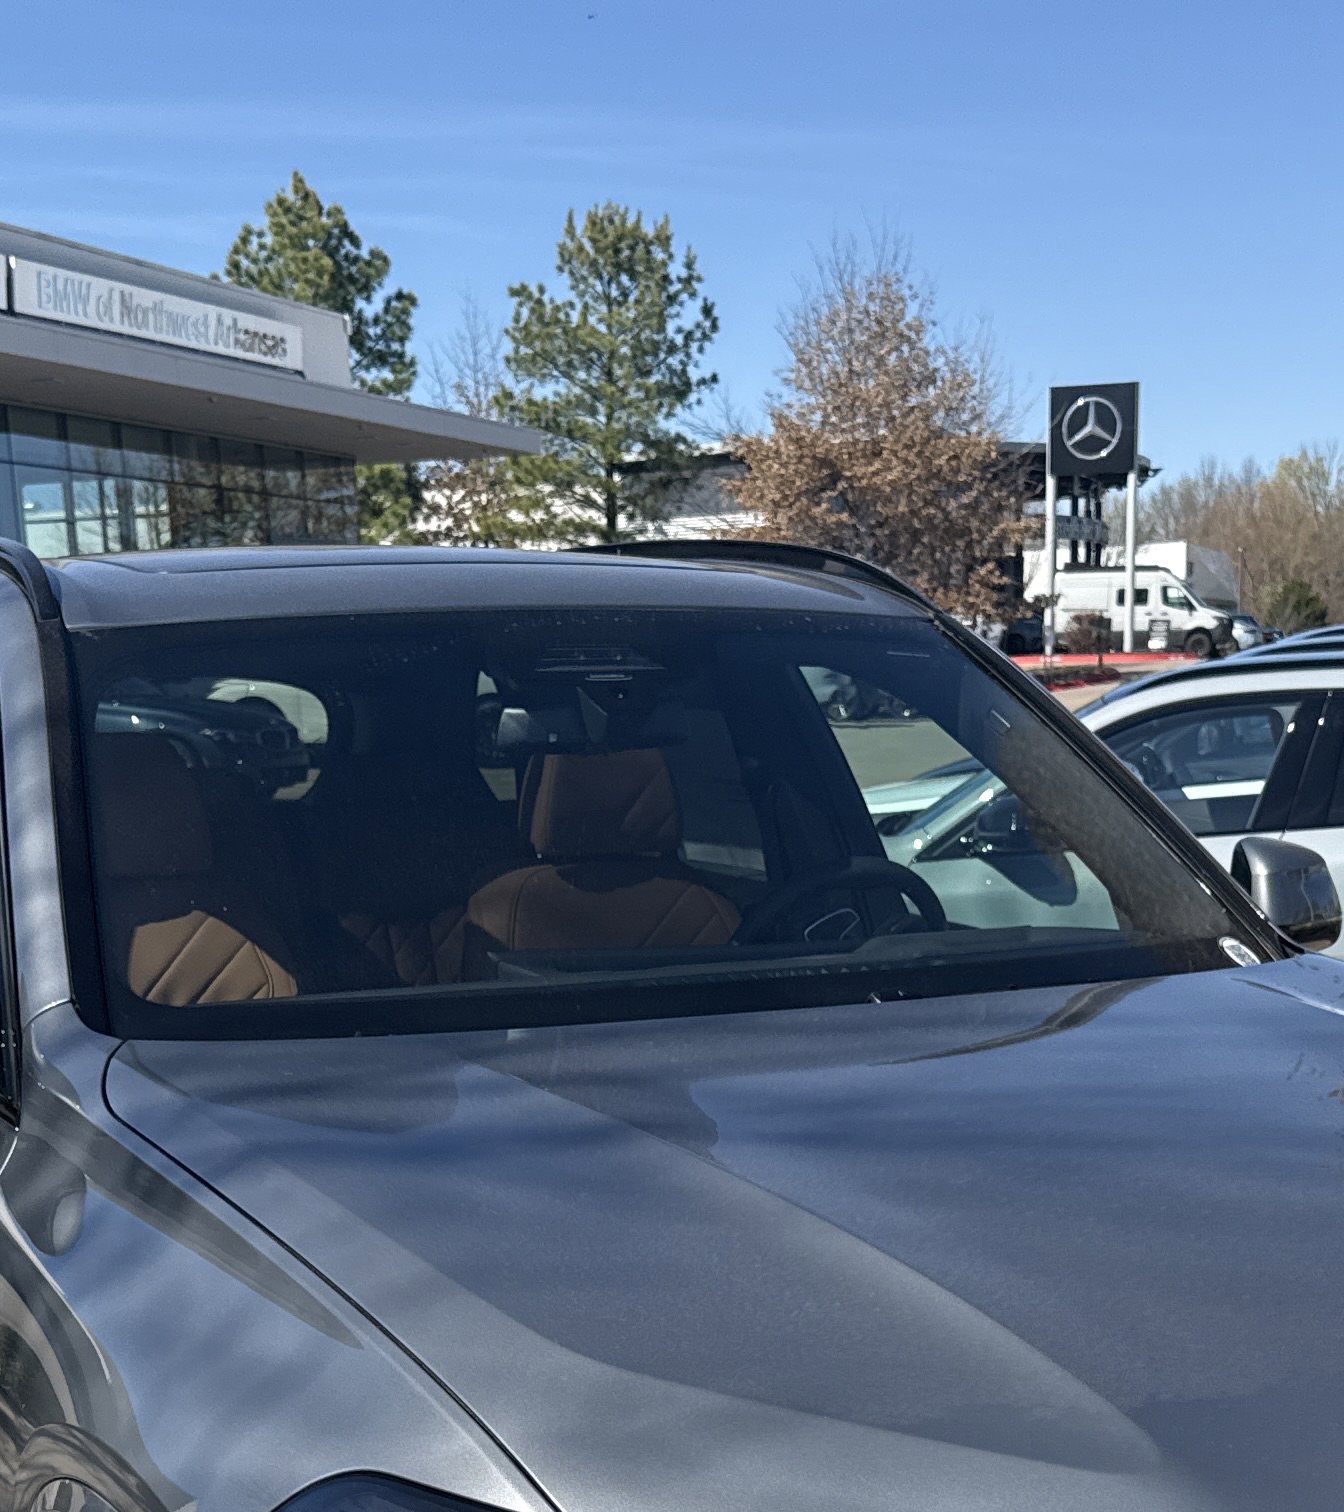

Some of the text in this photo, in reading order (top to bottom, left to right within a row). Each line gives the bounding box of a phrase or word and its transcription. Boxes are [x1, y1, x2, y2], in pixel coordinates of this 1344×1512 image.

[37, 270, 92, 319] BMW
[96, 288, 115, 324] of
[119, 289, 211, 347] Northwest
